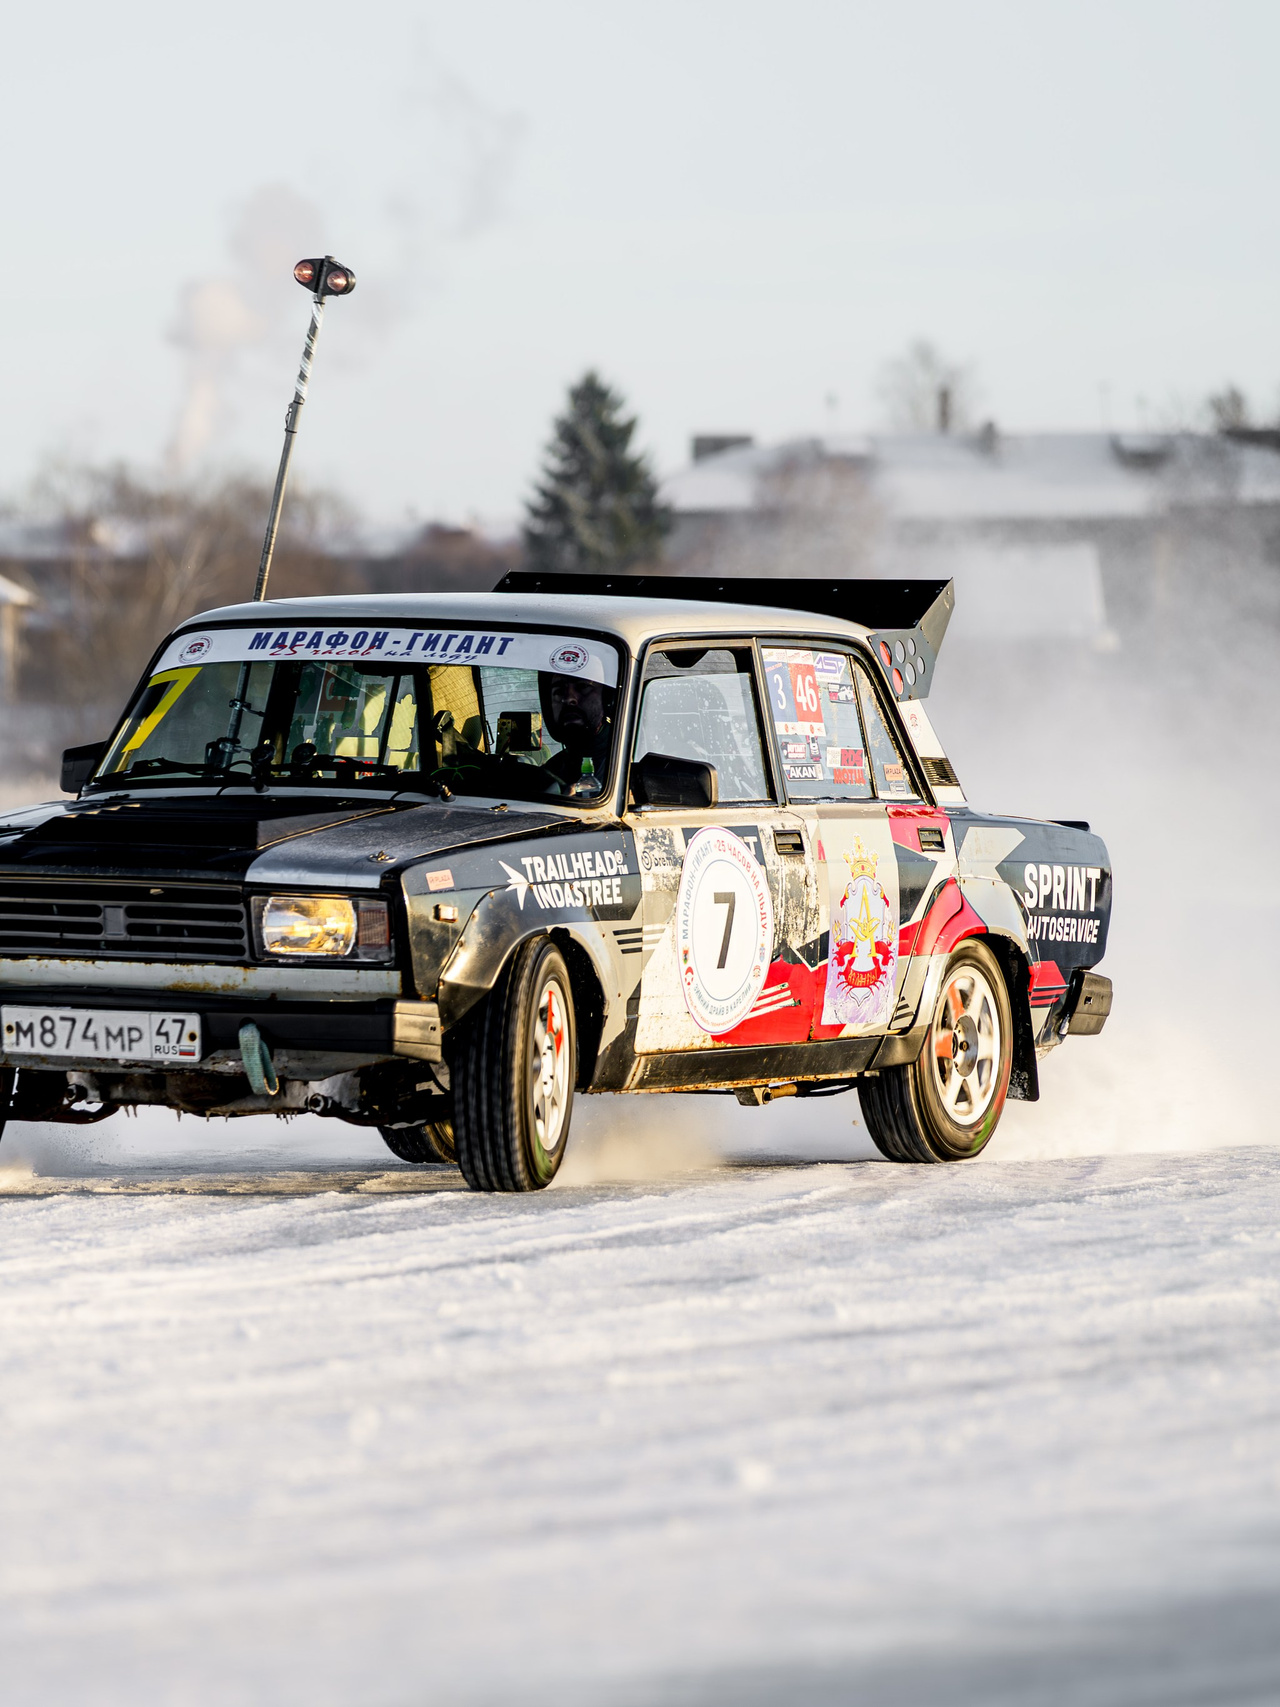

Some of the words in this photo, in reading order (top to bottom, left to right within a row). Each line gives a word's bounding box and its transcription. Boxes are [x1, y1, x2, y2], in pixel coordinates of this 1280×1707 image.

[269, 644, 306, 657] 25
[773, 673, 787, 710] 3
[796, 674, 818, 713] 46
[121, 667, 203, 753] 7
[532, 877, 623, 910] INDASTREE
[1024, 863, 1101, 912] SPRINT
[713, 891, 735, 969] 7
[1026, 915, 1101, 944] AUTOSERVICE
[155, 1018, 187, 1045] 47
[154, 1045, 178, 1055] RUS
